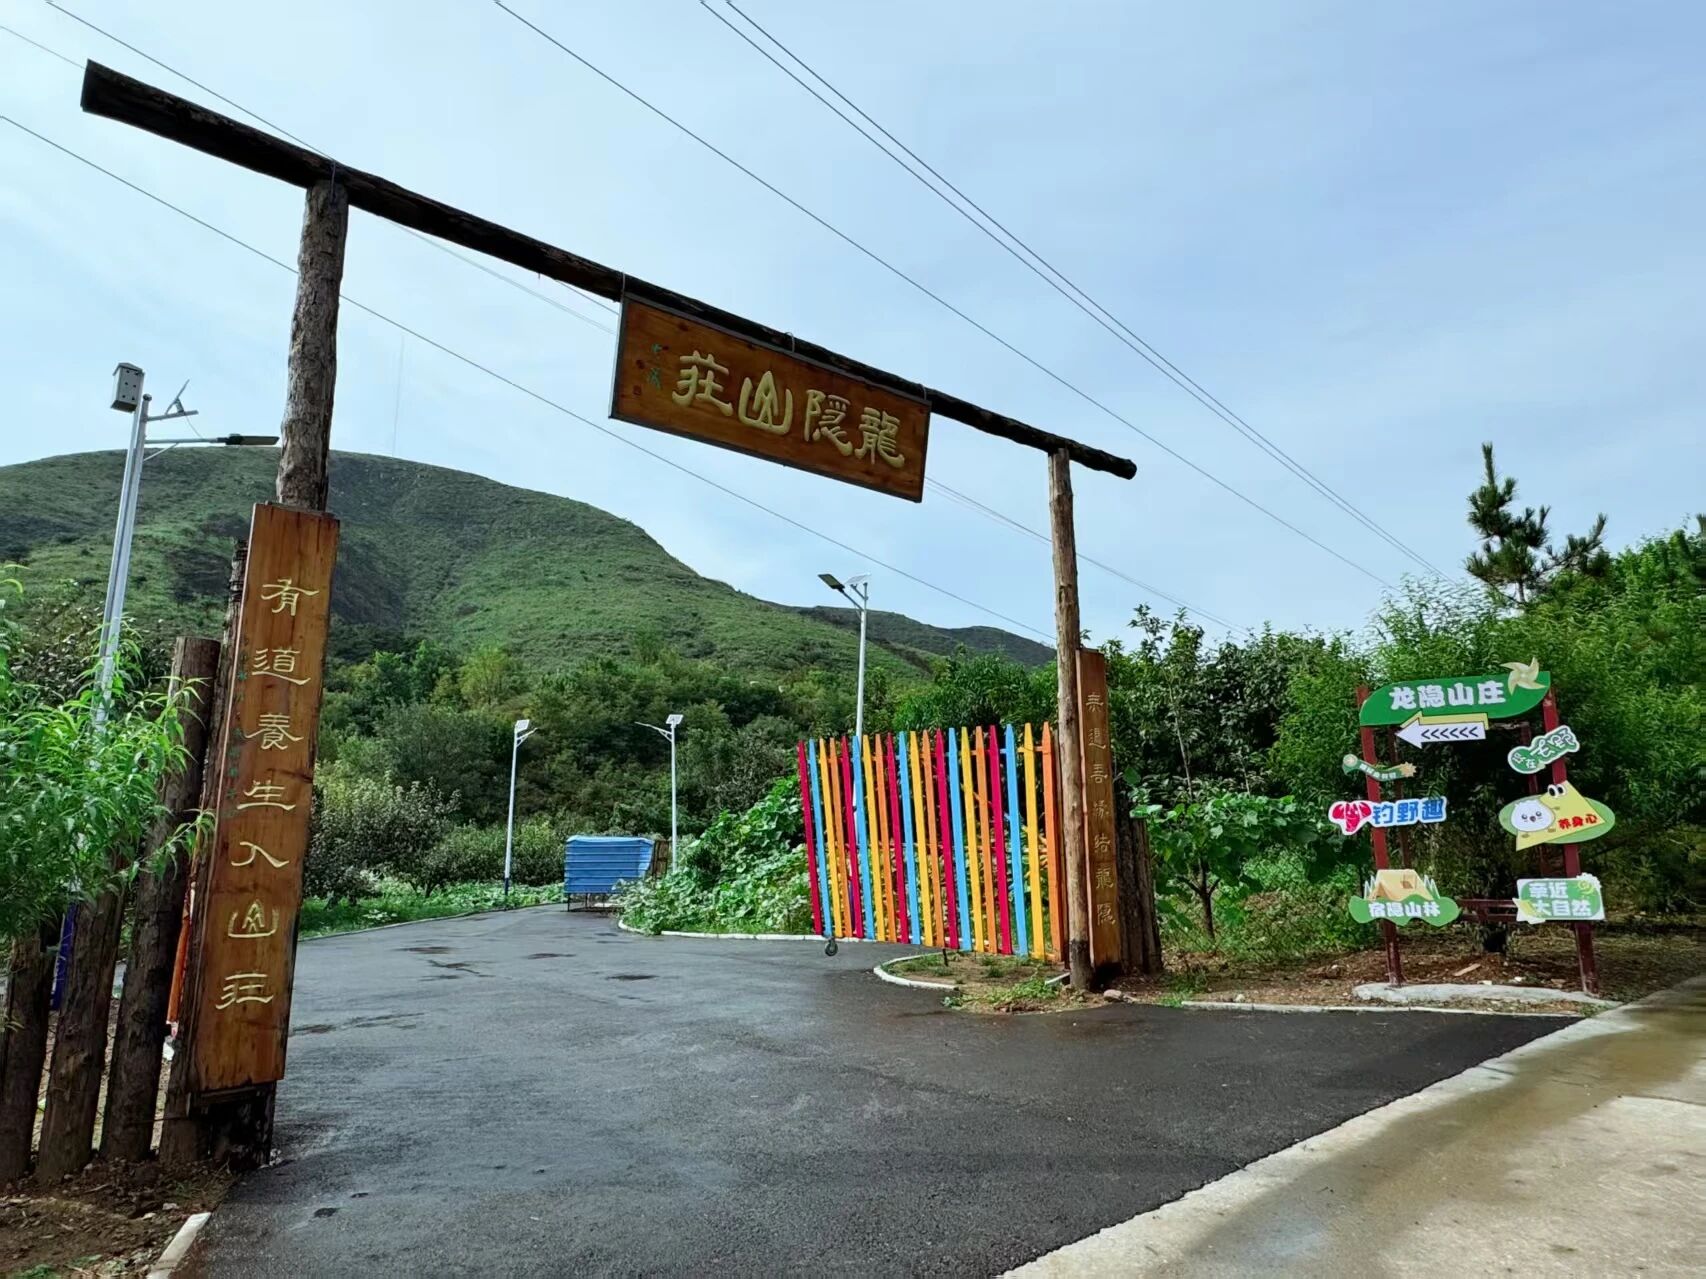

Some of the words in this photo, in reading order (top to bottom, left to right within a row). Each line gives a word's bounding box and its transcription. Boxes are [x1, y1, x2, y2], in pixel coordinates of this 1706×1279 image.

[1389, 679, 1507, 710] 龙隐山庄
[1373, 798, 1444, 825] 钓野趣
[1558, 813, 1598, 830] 养身心
[1533, 899, 1592, 917] 大自然
